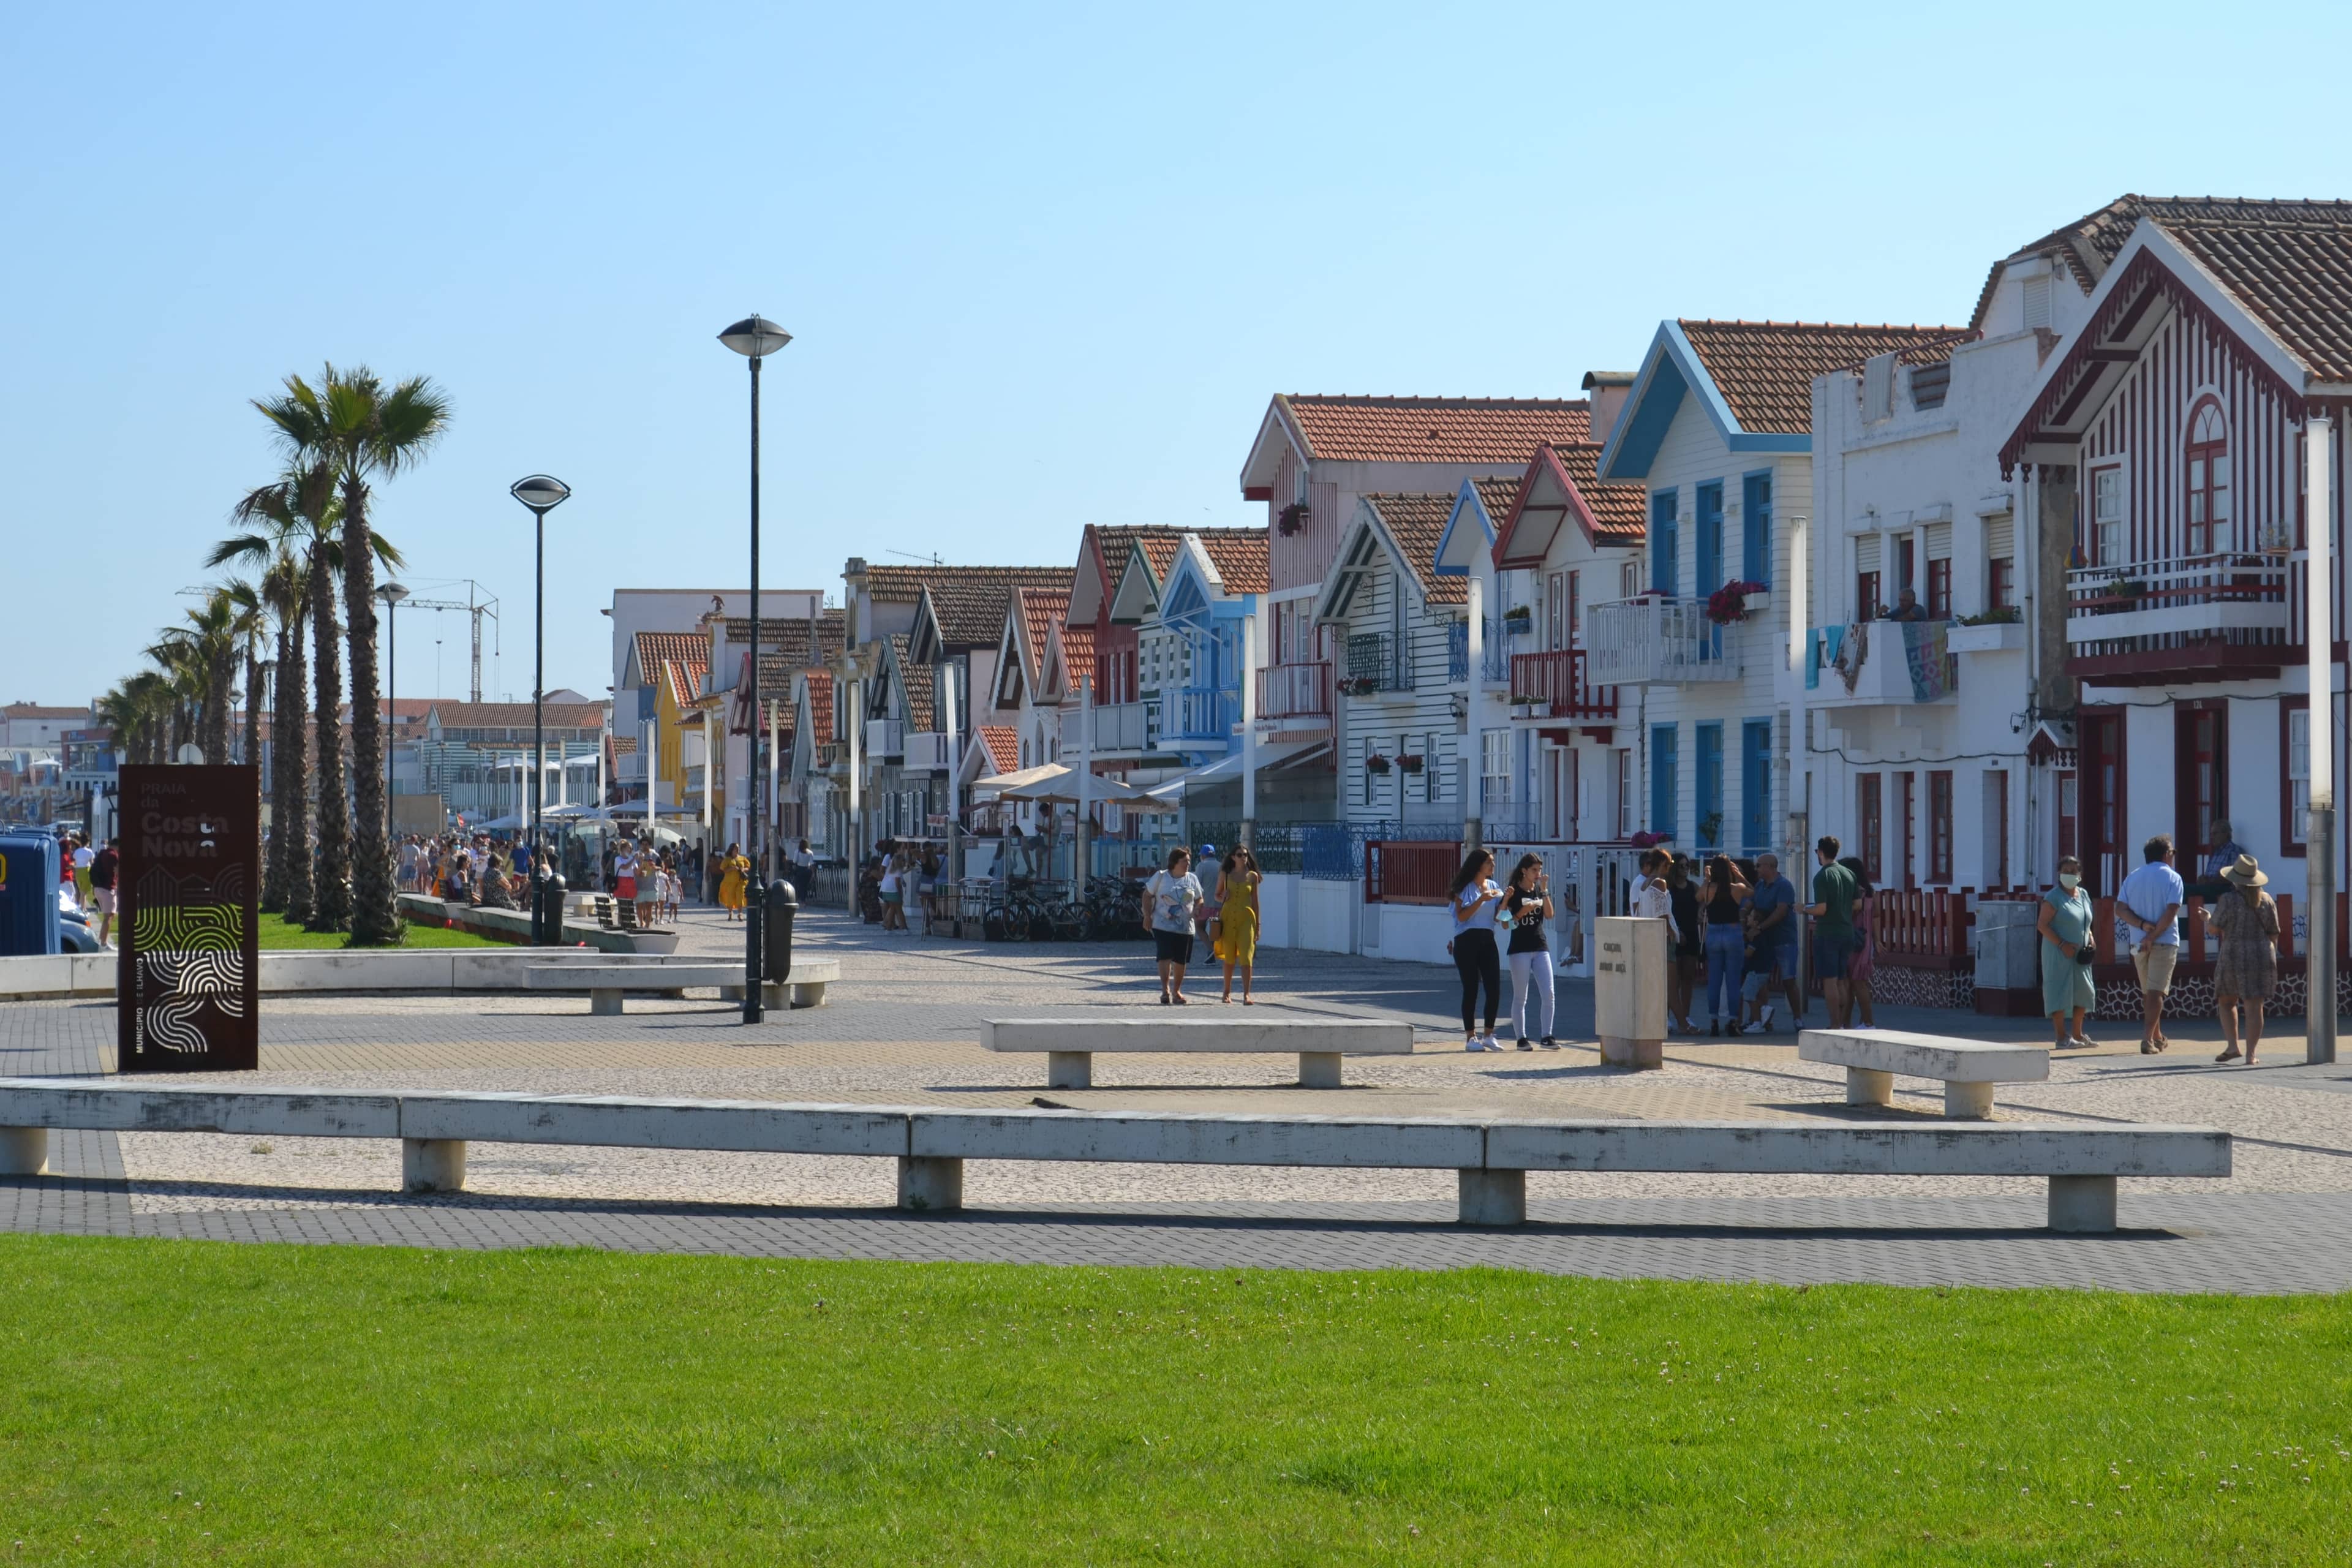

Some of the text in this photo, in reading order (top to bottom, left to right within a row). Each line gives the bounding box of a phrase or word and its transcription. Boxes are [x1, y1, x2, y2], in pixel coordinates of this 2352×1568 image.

[141, 783, 186, 794] PRAIA
[141, 794, 159, 809] da
[141, 812, 230, 834] Costa
[141, 835, 219, 858] Nova
